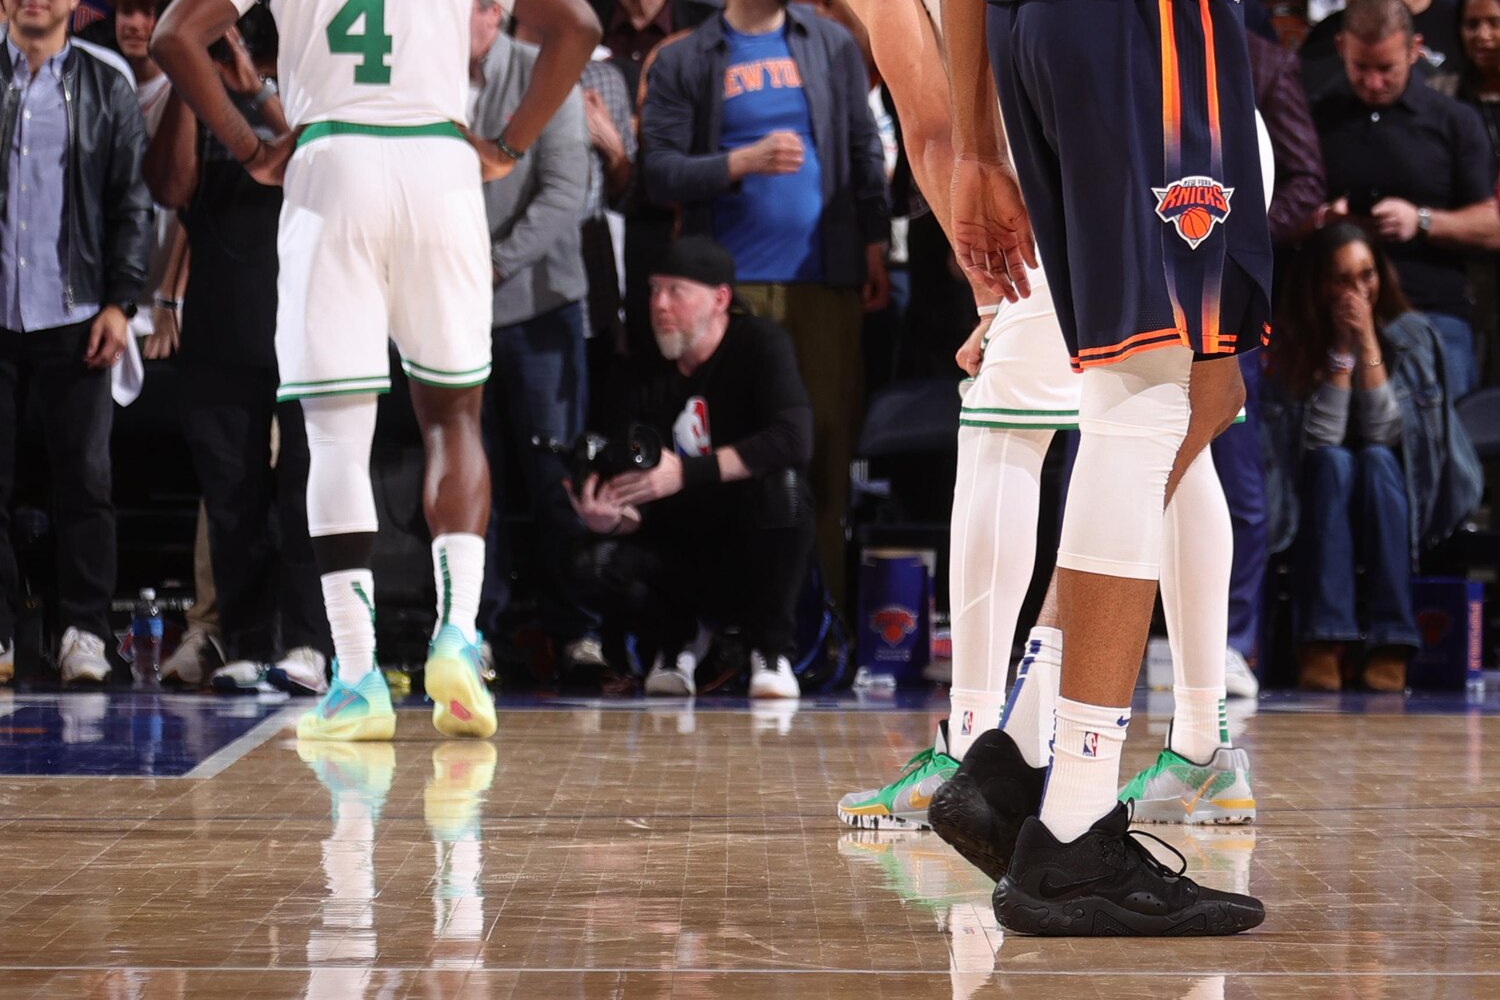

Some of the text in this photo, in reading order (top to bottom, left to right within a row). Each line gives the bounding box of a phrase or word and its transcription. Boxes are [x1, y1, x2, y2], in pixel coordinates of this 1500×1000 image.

[723, 57, 803, 99] EW YO
[1182, 179, 1197, 187] NEW
[1159, 184, 1228, 213] KNICKS
